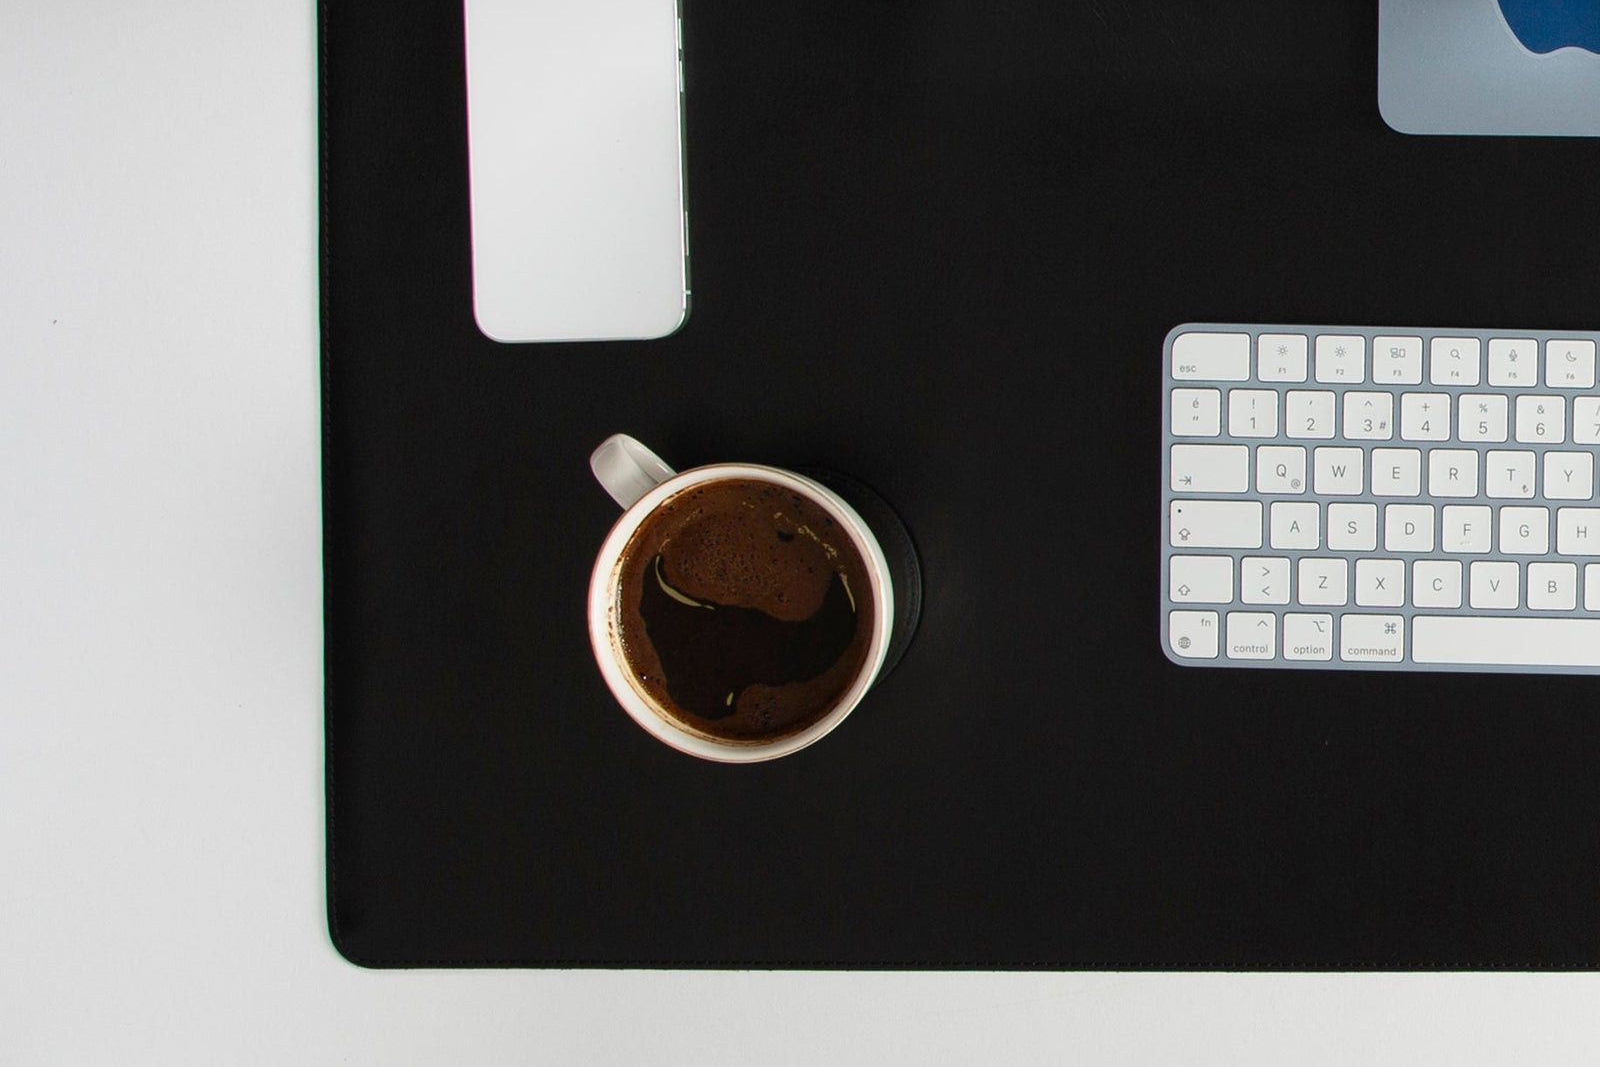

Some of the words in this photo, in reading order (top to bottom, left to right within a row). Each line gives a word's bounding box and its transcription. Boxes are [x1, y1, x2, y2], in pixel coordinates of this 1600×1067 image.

[1179, 365, 1197, 373] esc
[1278, 366, 1287, 374] F1
[1335, 368, 1345, 376] F2
[1392, 369, 1402, 377] F3
[1450, 370, 1460, 378] F4
[1508, 371, 1518, 379] F5
[1565, 372, 1575, 380] F6
[1192, 397, 1200, 409] é
[1249, 416, 1256, 430] 1
[1306, 417, 1316, 432] 2
[1363, 418, 1373, 433] 3
[1421, 420, 1431, 433] 4
[1478, 421, 1488, 435] 5
[1535, 422, 1546, 436] 6
[1275, 463, 1287, 479] Q
[1331, 465, 1347, 478] W
[1391, 466, 1401, 480] E
[1448, 467, 1459, 481] R
[1506, 468, 1516, 482] T
[1563, 469, 1574, 483] Y
[1289, 520, 1301, 534] A
[1347, 520, 1358, 535] S
[1404, 521, 1416, 536] D
[1463, 523, 1472, 537] F
[1518, 524, 1530, 538] G
[1576, 525, 1588, 539] H
[1318, 575, 1328, 589] Z
[1375, 577, 1385, 590] X
[1432, 577, 1443, 592] C
[1489, 579, 1501, 593] V
[1547, 580, 1558, 594] B
[1200, 617, 1211, 627] fn
[1233, 644, 1269, 654] control
[1293, 645, 1325, 655] option
[1347, 647, 1397, 657] command
